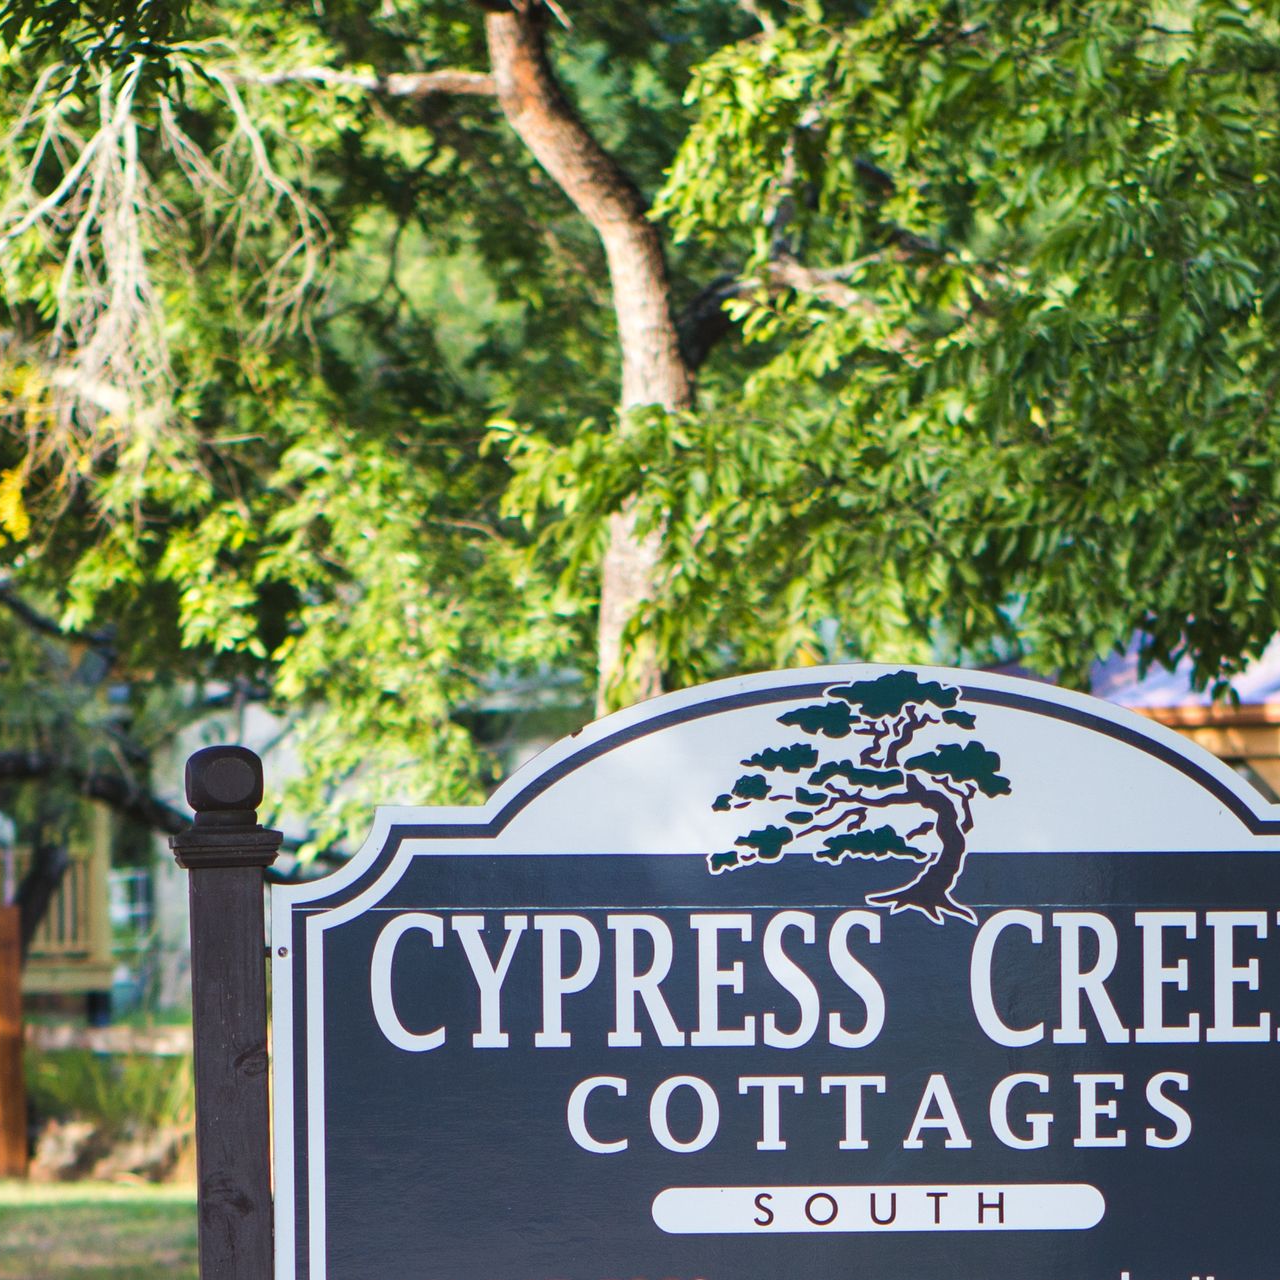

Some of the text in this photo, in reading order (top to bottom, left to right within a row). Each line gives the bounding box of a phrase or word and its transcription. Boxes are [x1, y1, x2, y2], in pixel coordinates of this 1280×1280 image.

[370, 912, 887, 1052] CYPRESS
[567, 1071, 1193, 1154] COTTAGES
[753, 1191, 1006, 1227] SOUTH
